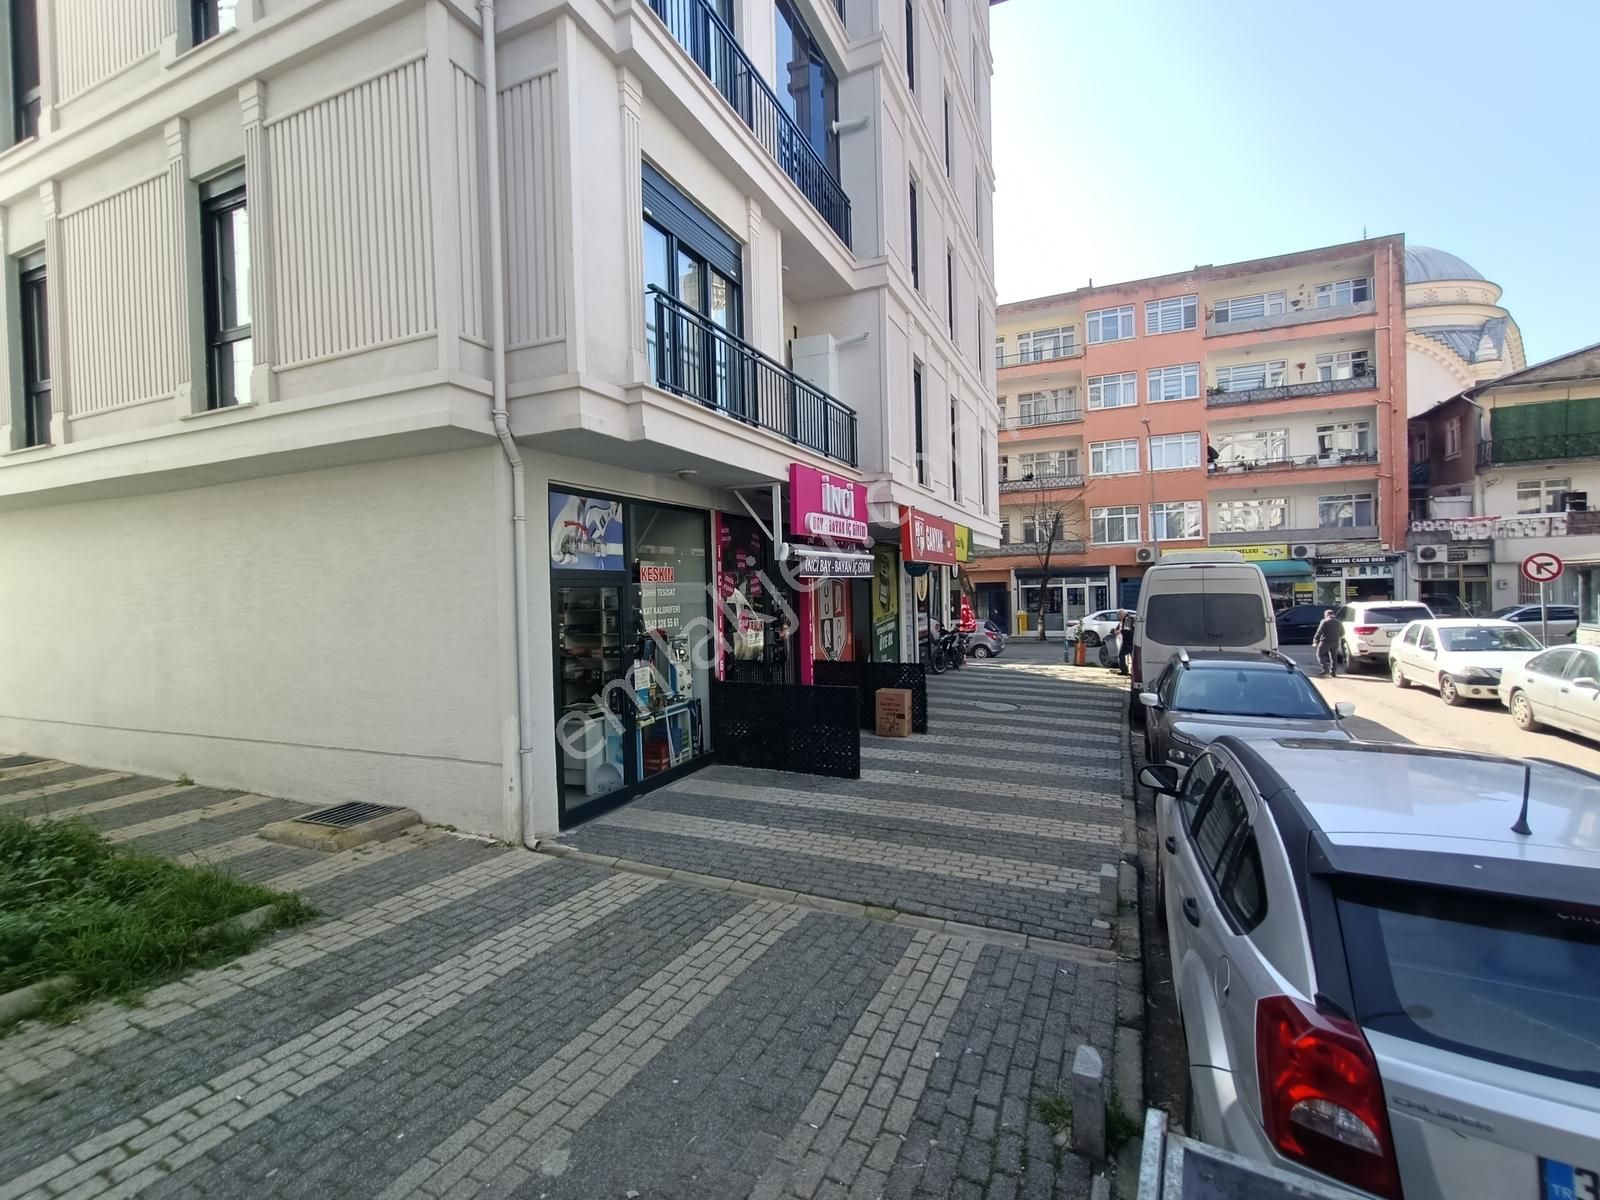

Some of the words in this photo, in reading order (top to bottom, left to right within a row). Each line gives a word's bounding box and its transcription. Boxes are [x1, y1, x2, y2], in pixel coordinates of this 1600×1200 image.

[822, 475, 855, 518] İNCİ
[812, 516, 824, 531] BAY
[640, 563, 675, 583] KESKİN
[804, 556, 820, 572] İNCİ
[819, 559, 831, 573] BAY
[834, 560, 852, 573] BAYAN
[852, 560, 858, 575] İÇ
[657, 587, 676, 597] TESİSAT
